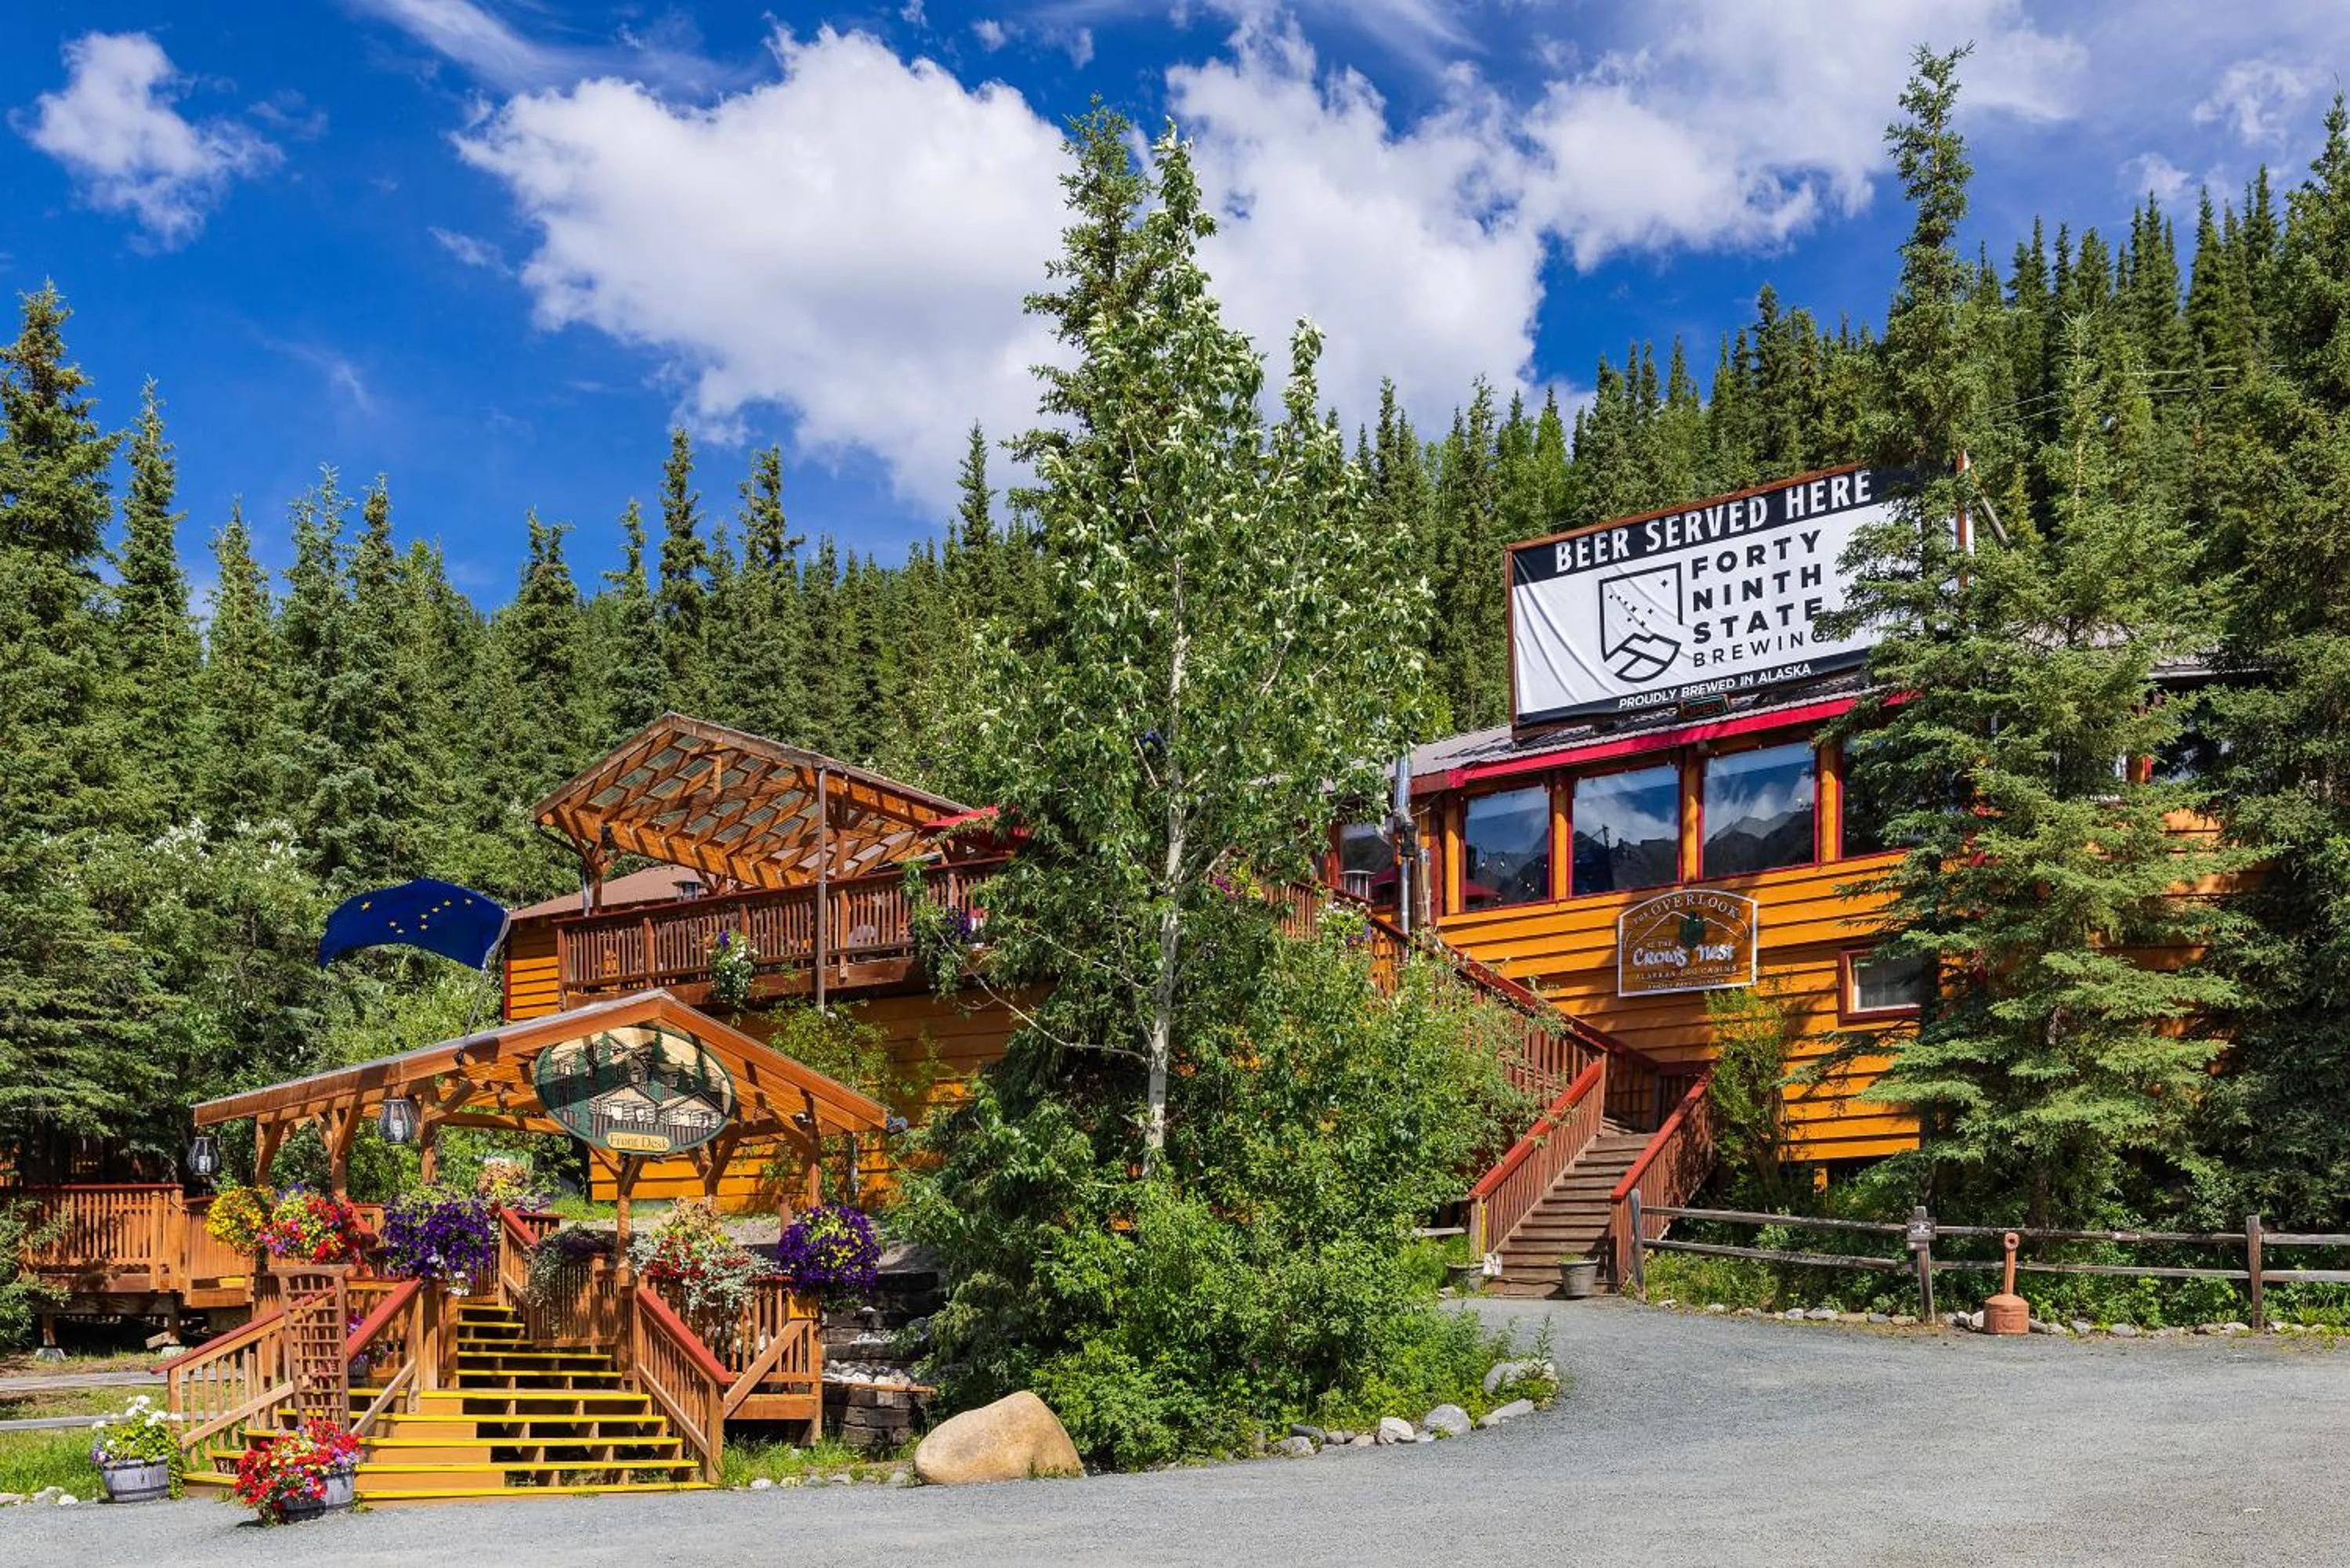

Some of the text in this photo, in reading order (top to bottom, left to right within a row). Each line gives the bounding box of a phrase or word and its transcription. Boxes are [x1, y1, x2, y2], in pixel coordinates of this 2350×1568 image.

[1554, 471, 1872, 573] BEER SERVED HERE
[1692, 529, 1821, 580] FORTY
[1693, 563, 1822, 612] NINTH
[1693, 597, 1823, 644] STATE
[1693, 627, 1825, 667] BREWING
[1618, 663, 1812, 709] PROUDLY BREWED IN ALASKA
[1650, 894, 1741, 919] OVERLOOK
[609, 1133, 668, 1149] Front Desk
